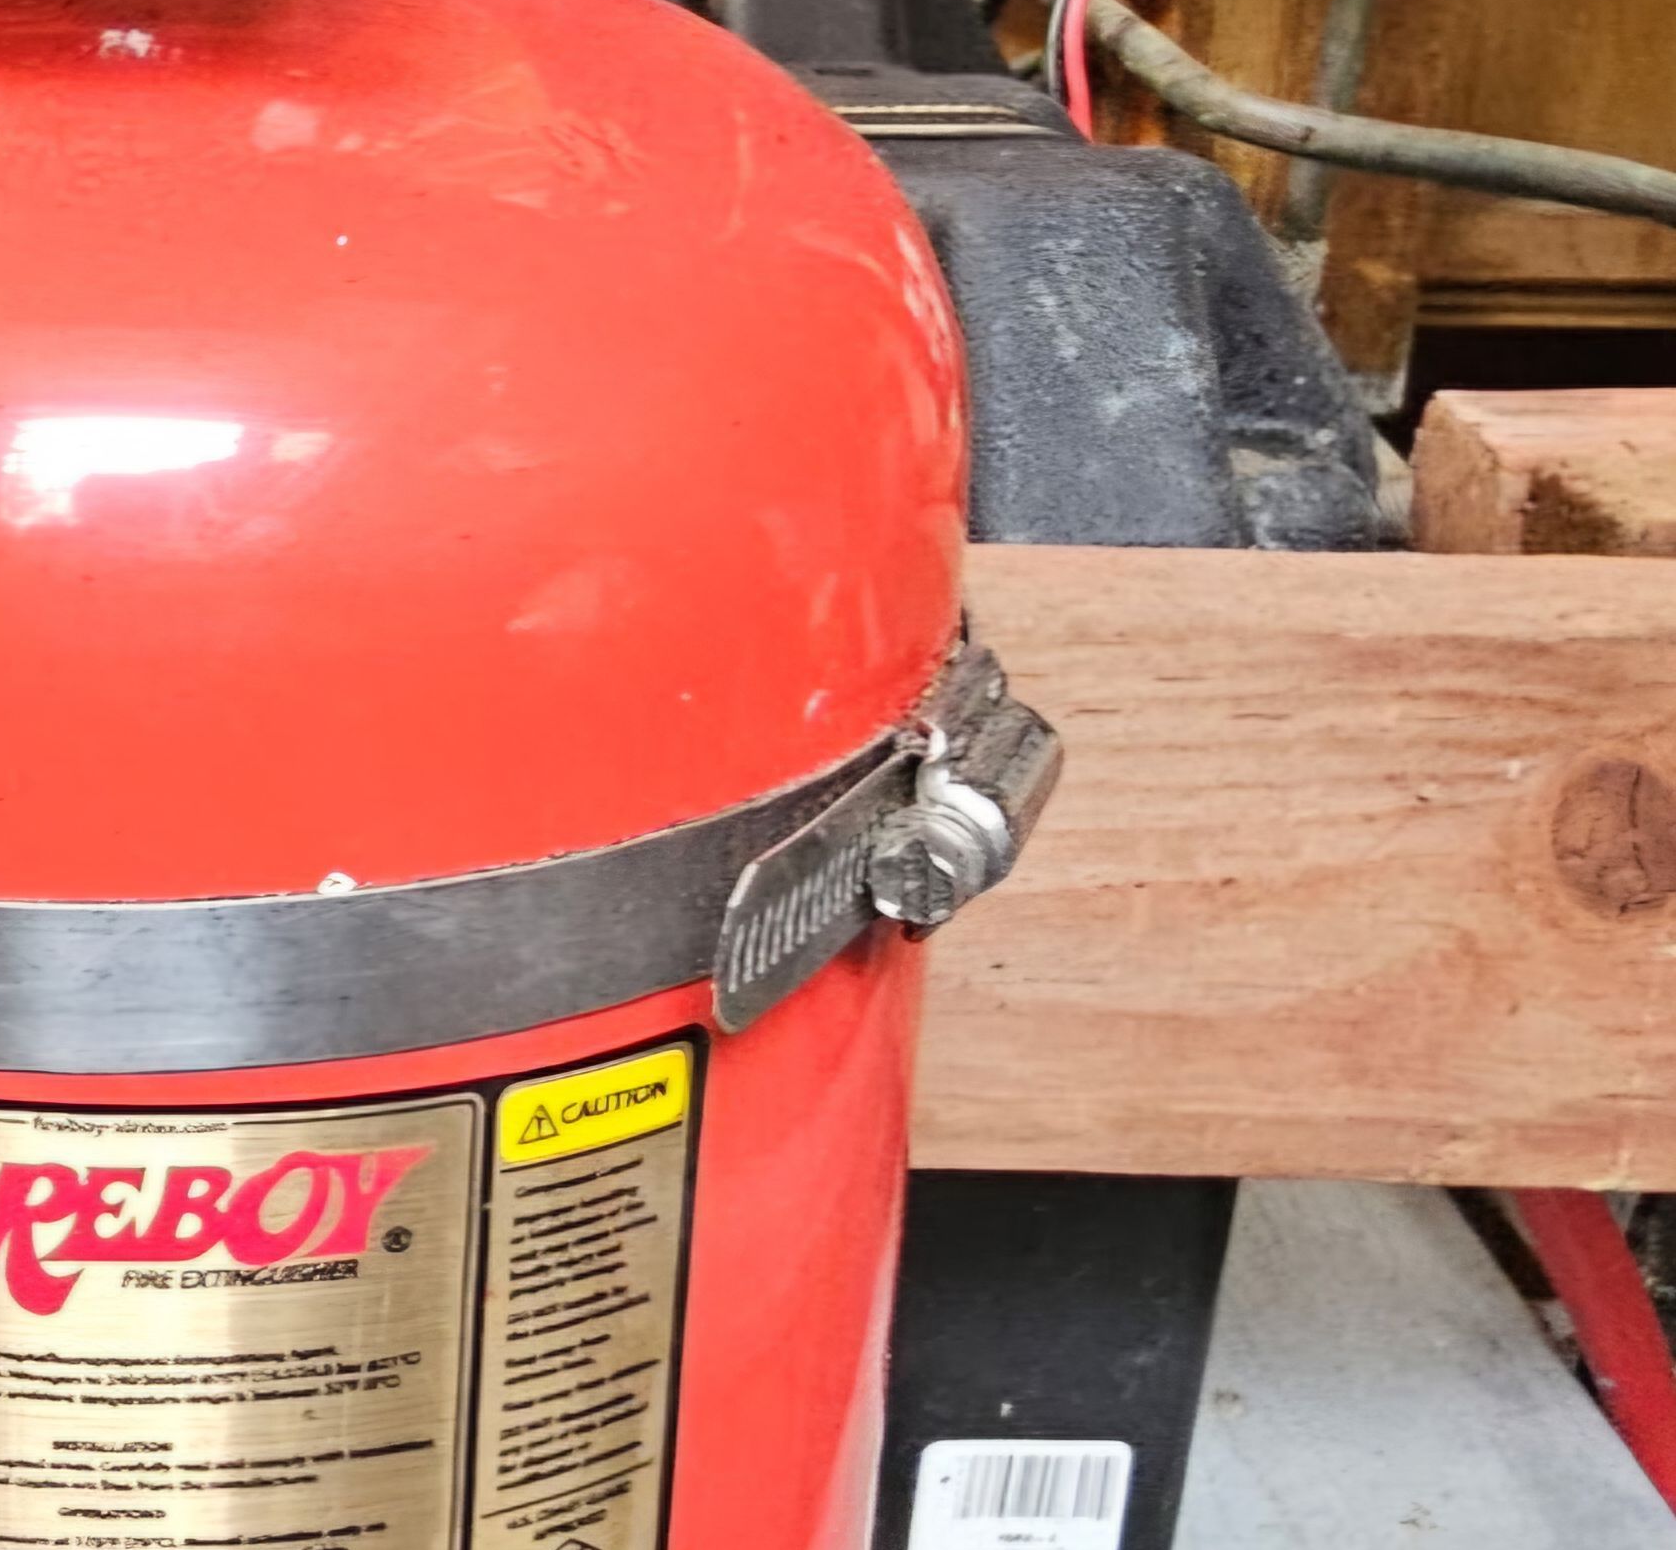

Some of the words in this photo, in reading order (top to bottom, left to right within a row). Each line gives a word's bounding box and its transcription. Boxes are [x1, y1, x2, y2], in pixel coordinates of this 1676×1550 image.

[561, 1077, 669, 1124] CAUTION
[122, 1270, 173, 1289] FIRE
[180, 1259, 359, 1288] EXTINGUISHER
